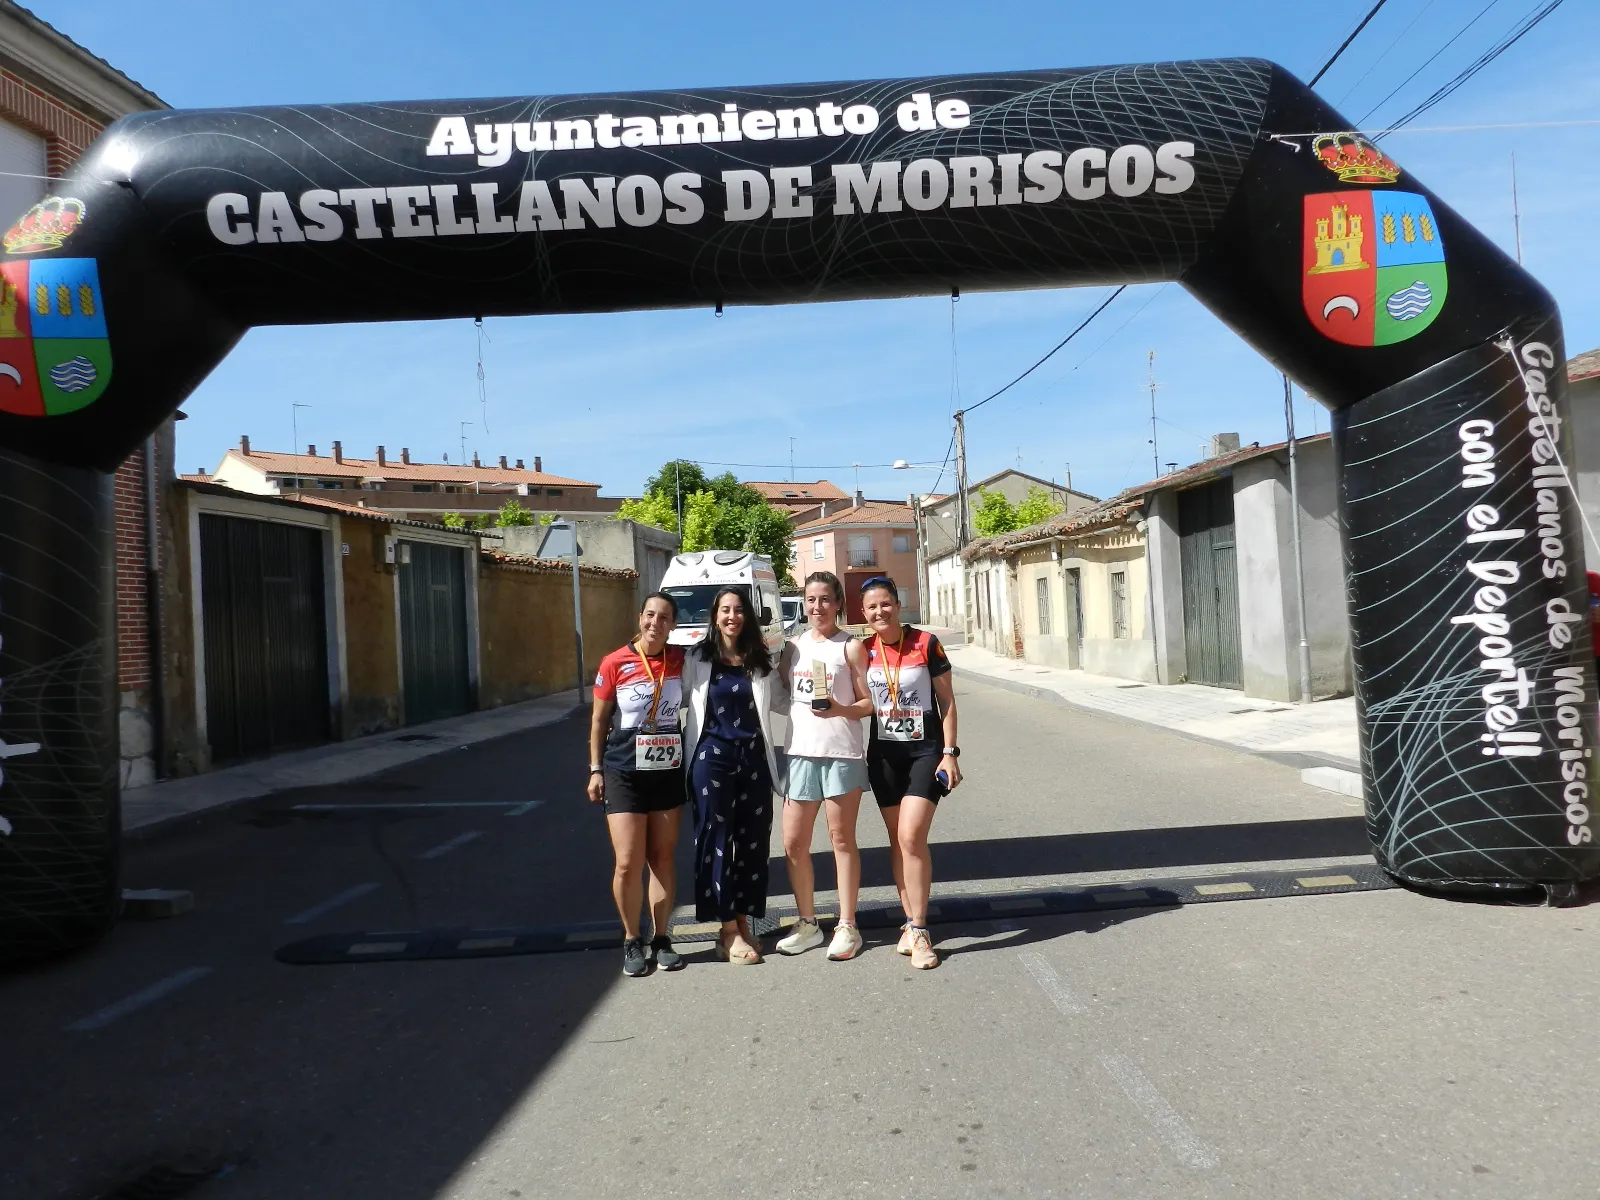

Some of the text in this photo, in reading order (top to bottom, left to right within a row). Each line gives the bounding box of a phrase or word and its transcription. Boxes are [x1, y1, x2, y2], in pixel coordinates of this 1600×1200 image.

[427, 92, 971, 168] Ayuntamiento de
[206, 141, 1195, 245] CASTELLANOS DE MORISCOS
[1466, 504, 1526, 544] el
[1521, 341, 1569, 579] Castellanos
[1546, 597, 1582, 649] de
[644, 745, 676, 762] 429
[884, 717, 915, 733] 423
